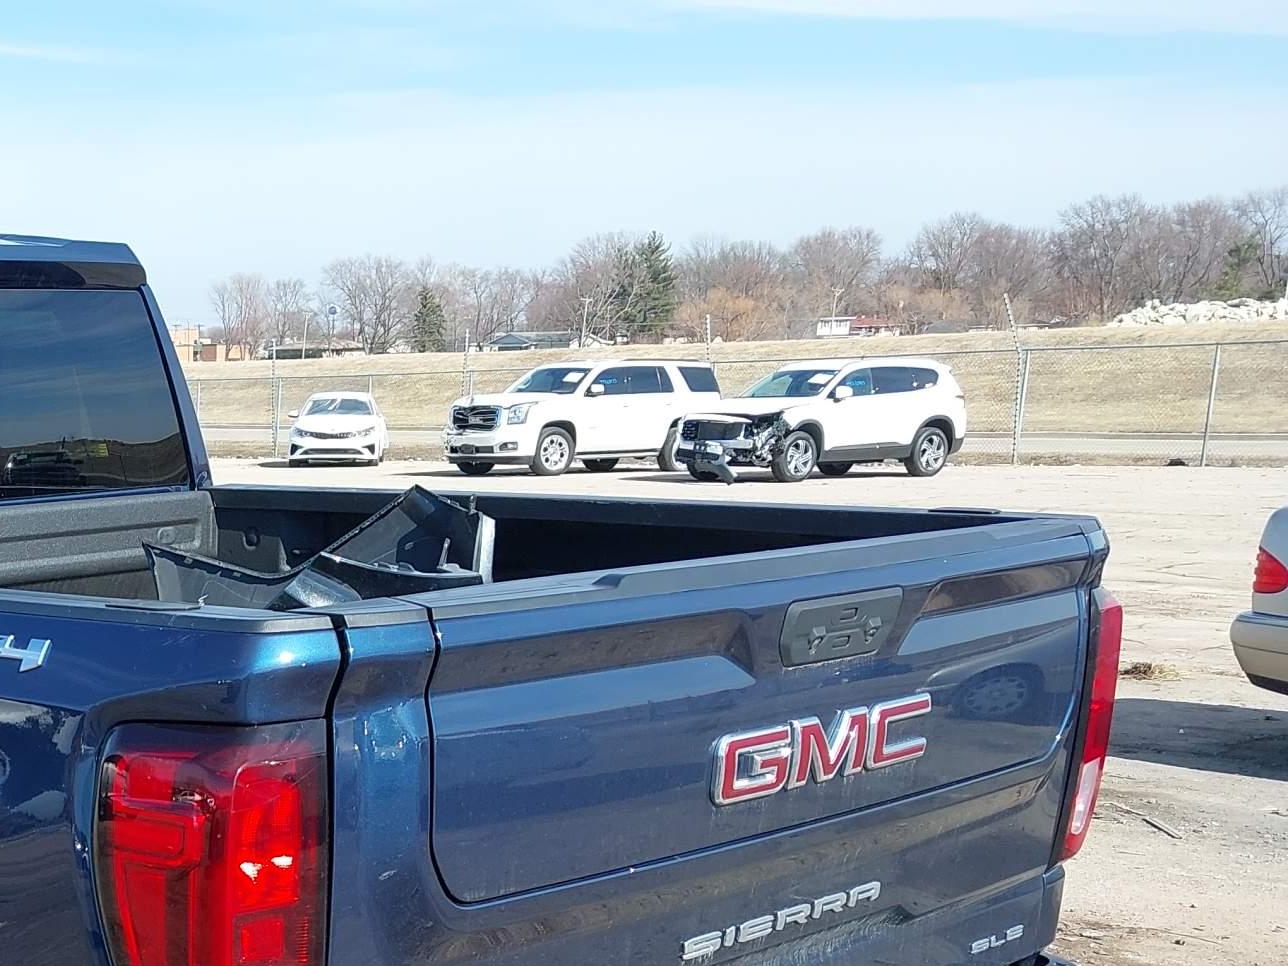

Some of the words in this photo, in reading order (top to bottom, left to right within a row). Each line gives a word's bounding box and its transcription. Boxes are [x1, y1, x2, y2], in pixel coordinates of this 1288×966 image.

[712, 692, 932, 807] GMC
[681, 881, 882, 961] SIERRA
[970, 924, 1025, 954] SLE
